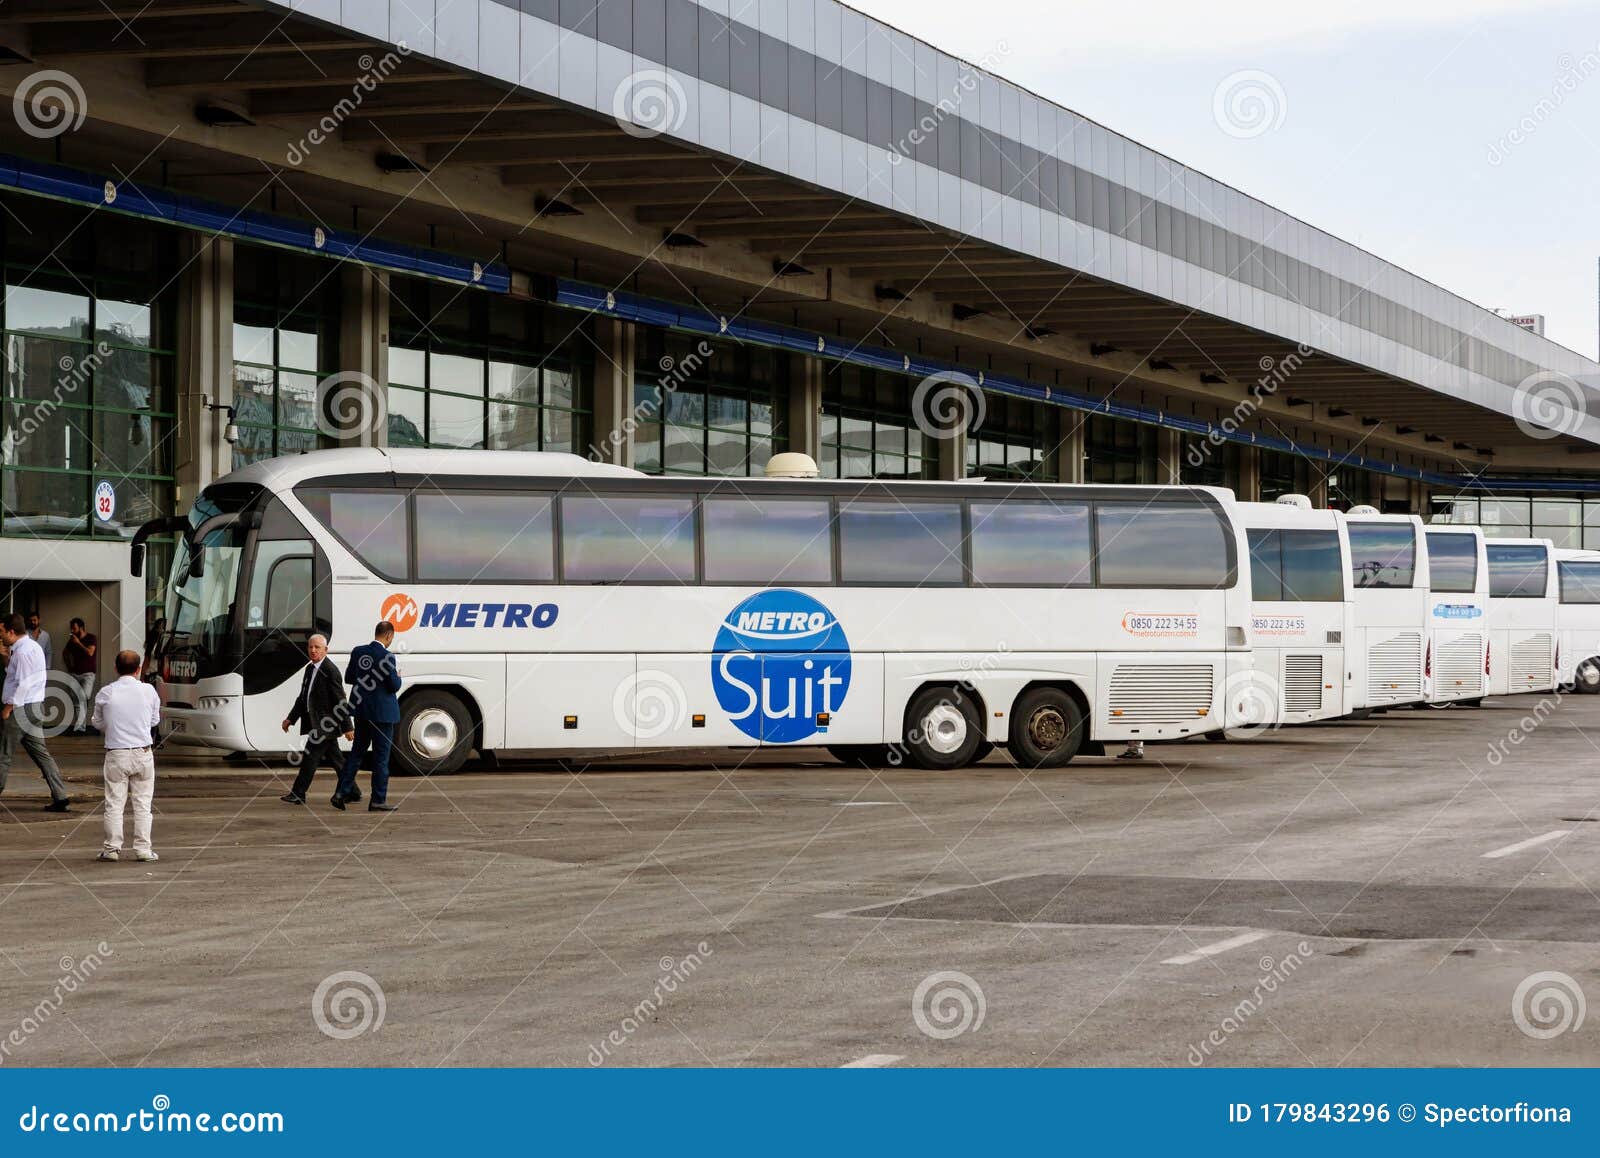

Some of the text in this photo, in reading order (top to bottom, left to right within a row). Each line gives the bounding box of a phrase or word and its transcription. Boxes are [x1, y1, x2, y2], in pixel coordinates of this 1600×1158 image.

[99, 497, 111, 513] 32
[419, 603, 559, 629] METRO
[738, 611, 826, 631] METRO
[1130, 618, 1197, 629] 0850 222 34 55
[1270, 619, 1284, 629] 222
[169, 660, 198, 678] METRO
[719, 650, 843, 721] Suit
